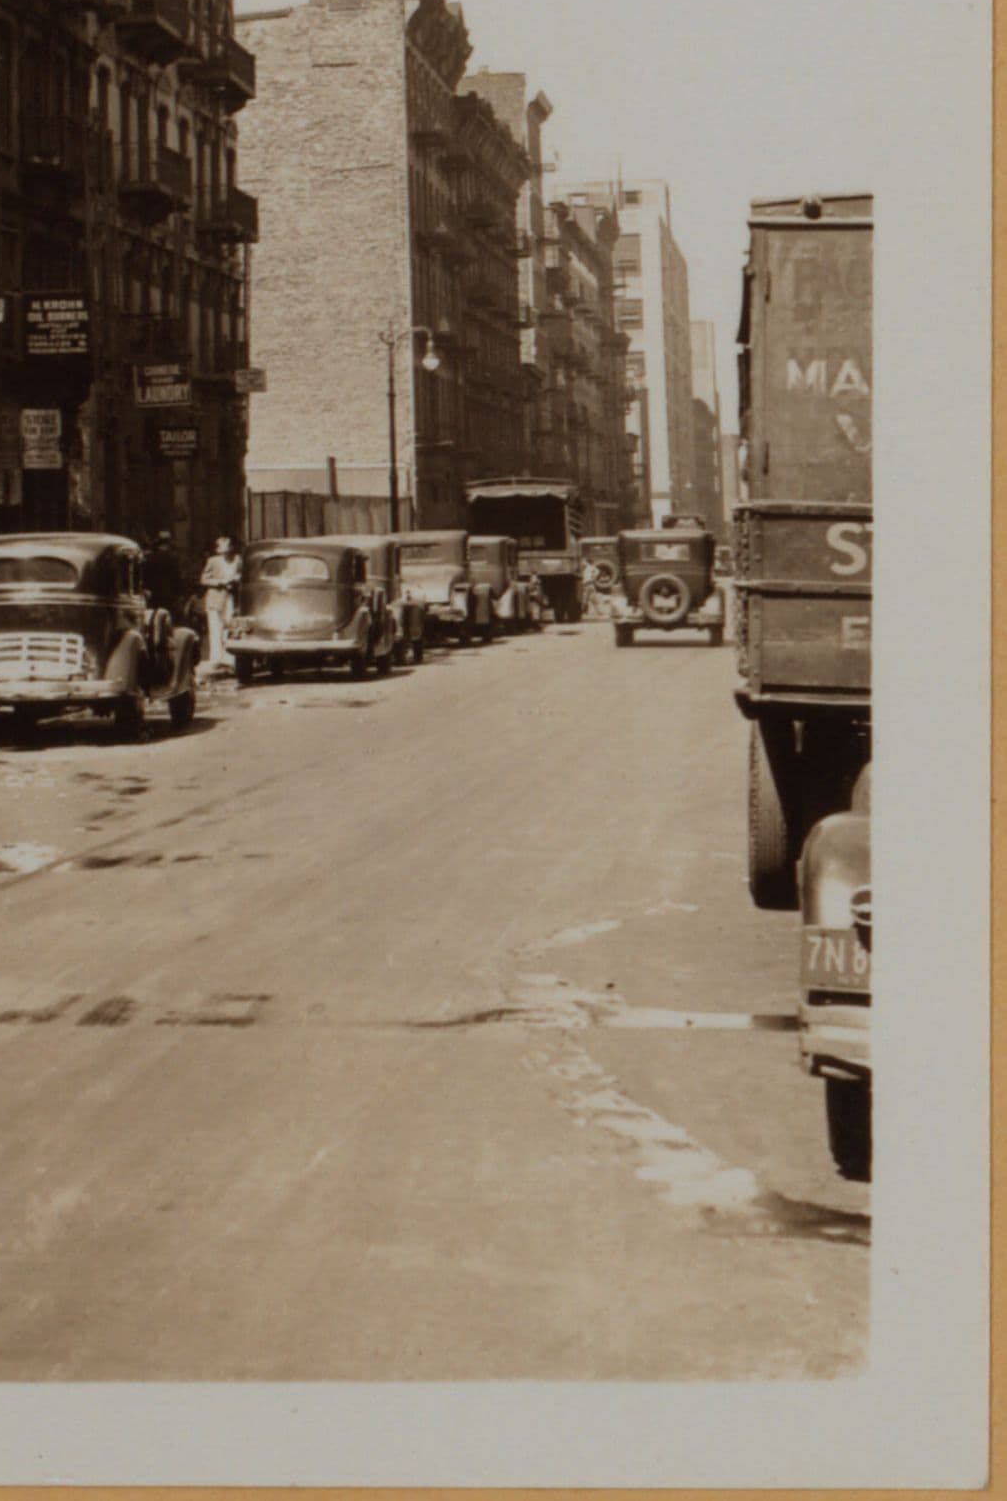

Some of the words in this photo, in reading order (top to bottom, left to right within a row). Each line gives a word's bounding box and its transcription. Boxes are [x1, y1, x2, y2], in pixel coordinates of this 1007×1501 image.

[137, 383, 190, 403] LAUNDRY
[159, 429, 197, 443] TAILOR
[826, 522, 872, 576] S
